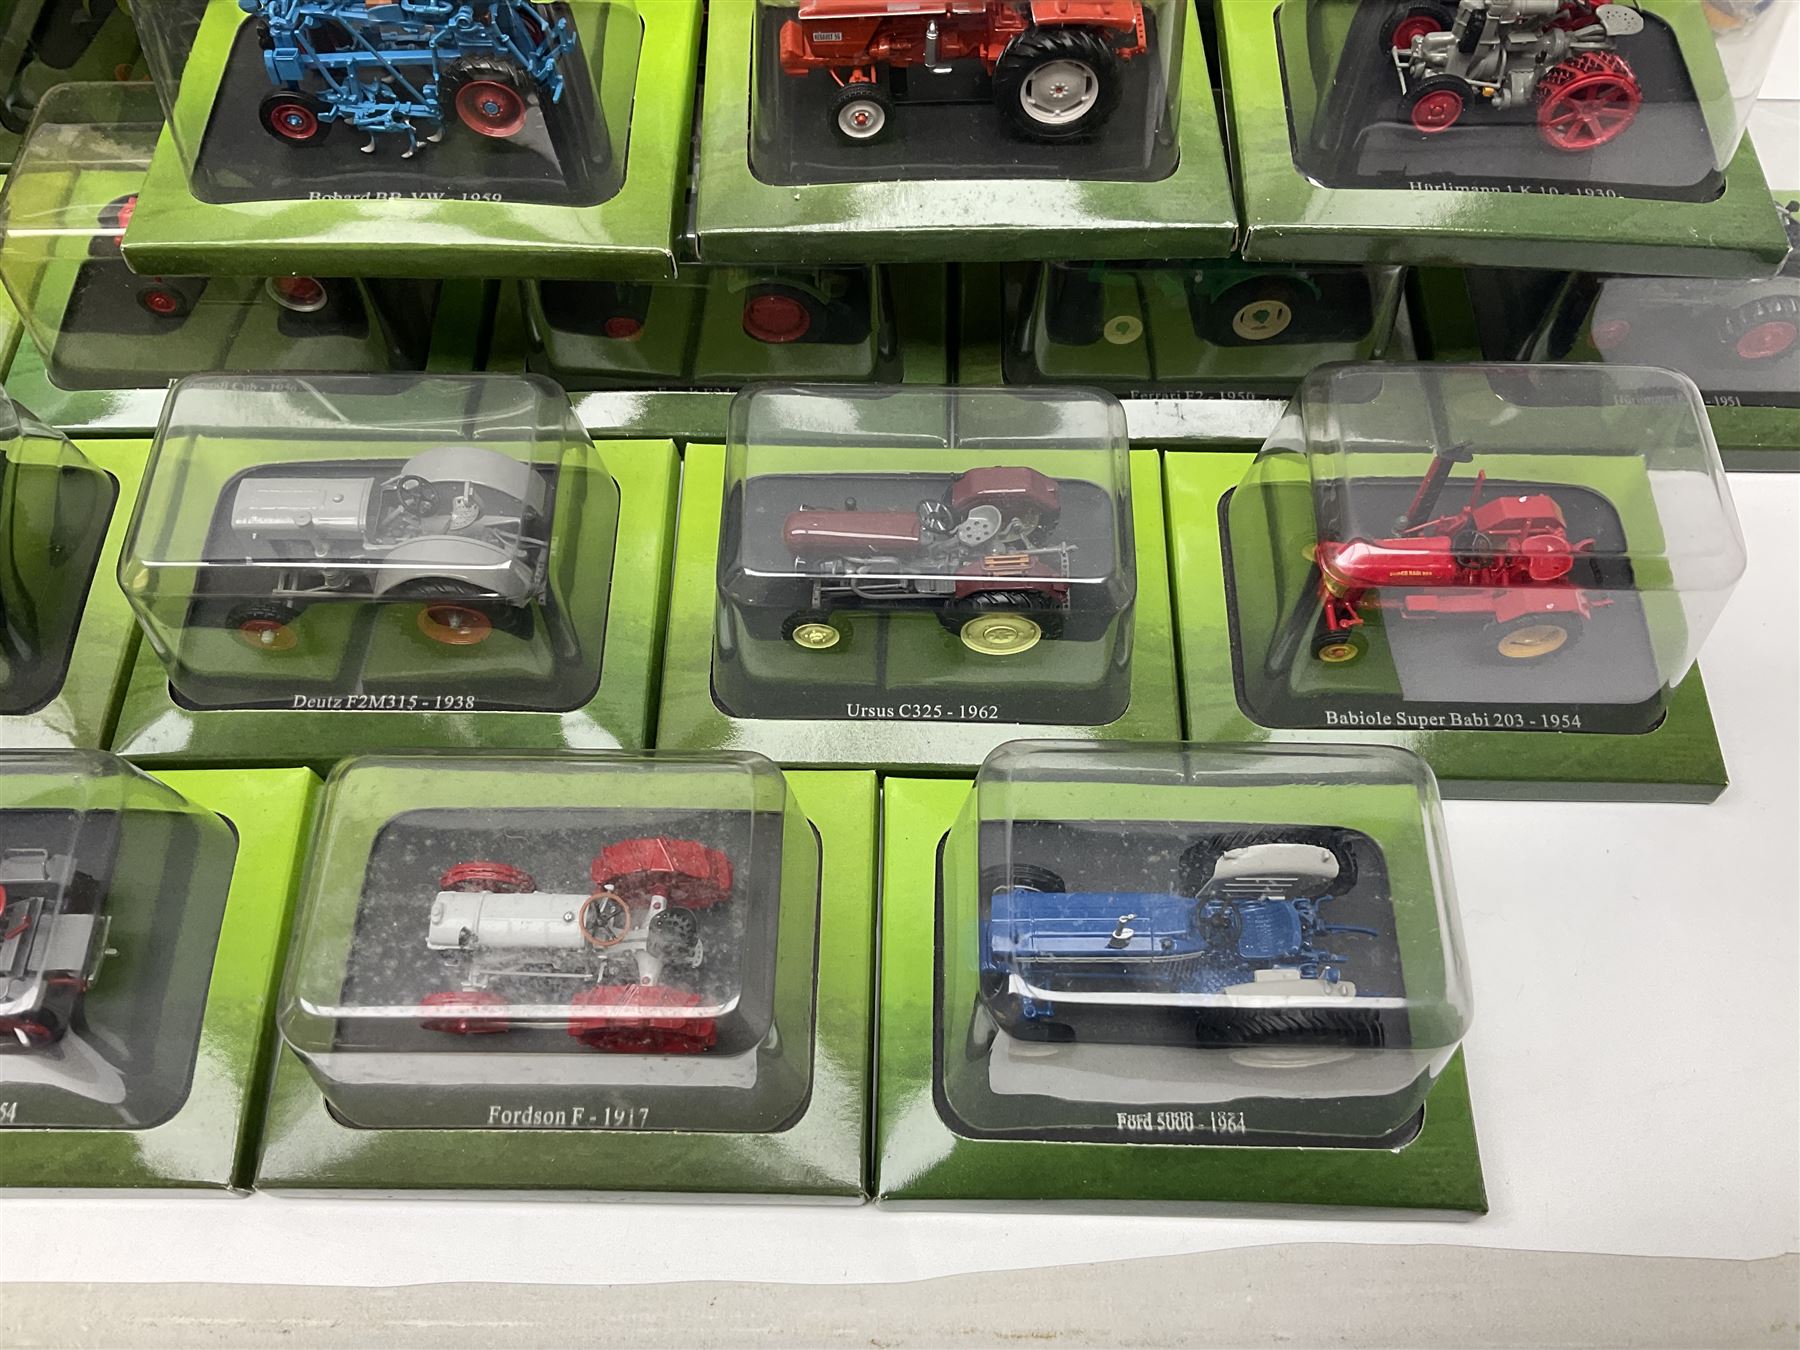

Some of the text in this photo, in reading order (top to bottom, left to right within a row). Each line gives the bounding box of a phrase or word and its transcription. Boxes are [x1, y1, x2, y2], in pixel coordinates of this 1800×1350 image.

[1714, 395, 1741, 407] 1951
[292, 694, 342, 709] Deutz
[346, 695, 418, 710] F2M315
[434, 696, 475, 710] 1938
[847, 703, 895, 718] Ursus
[899, 704, 942, 718] C325
[959, 705, 998, 719] 1962
[1325, 710, 1392, 726] Babiole
[1396, 712, 1445, 729] Super
[1449, 712, 1490, 727] Babi
[1493, 713, 1524, 727] 203
[1542, 714, 1582, 729] 1954
[487, 1105, 566, 1125] Fordson
[571, 1107, 585, 1126] F
[605, 1107, 649, 1128] 1917
[1116, 1112, 1152, 1131] Ford
